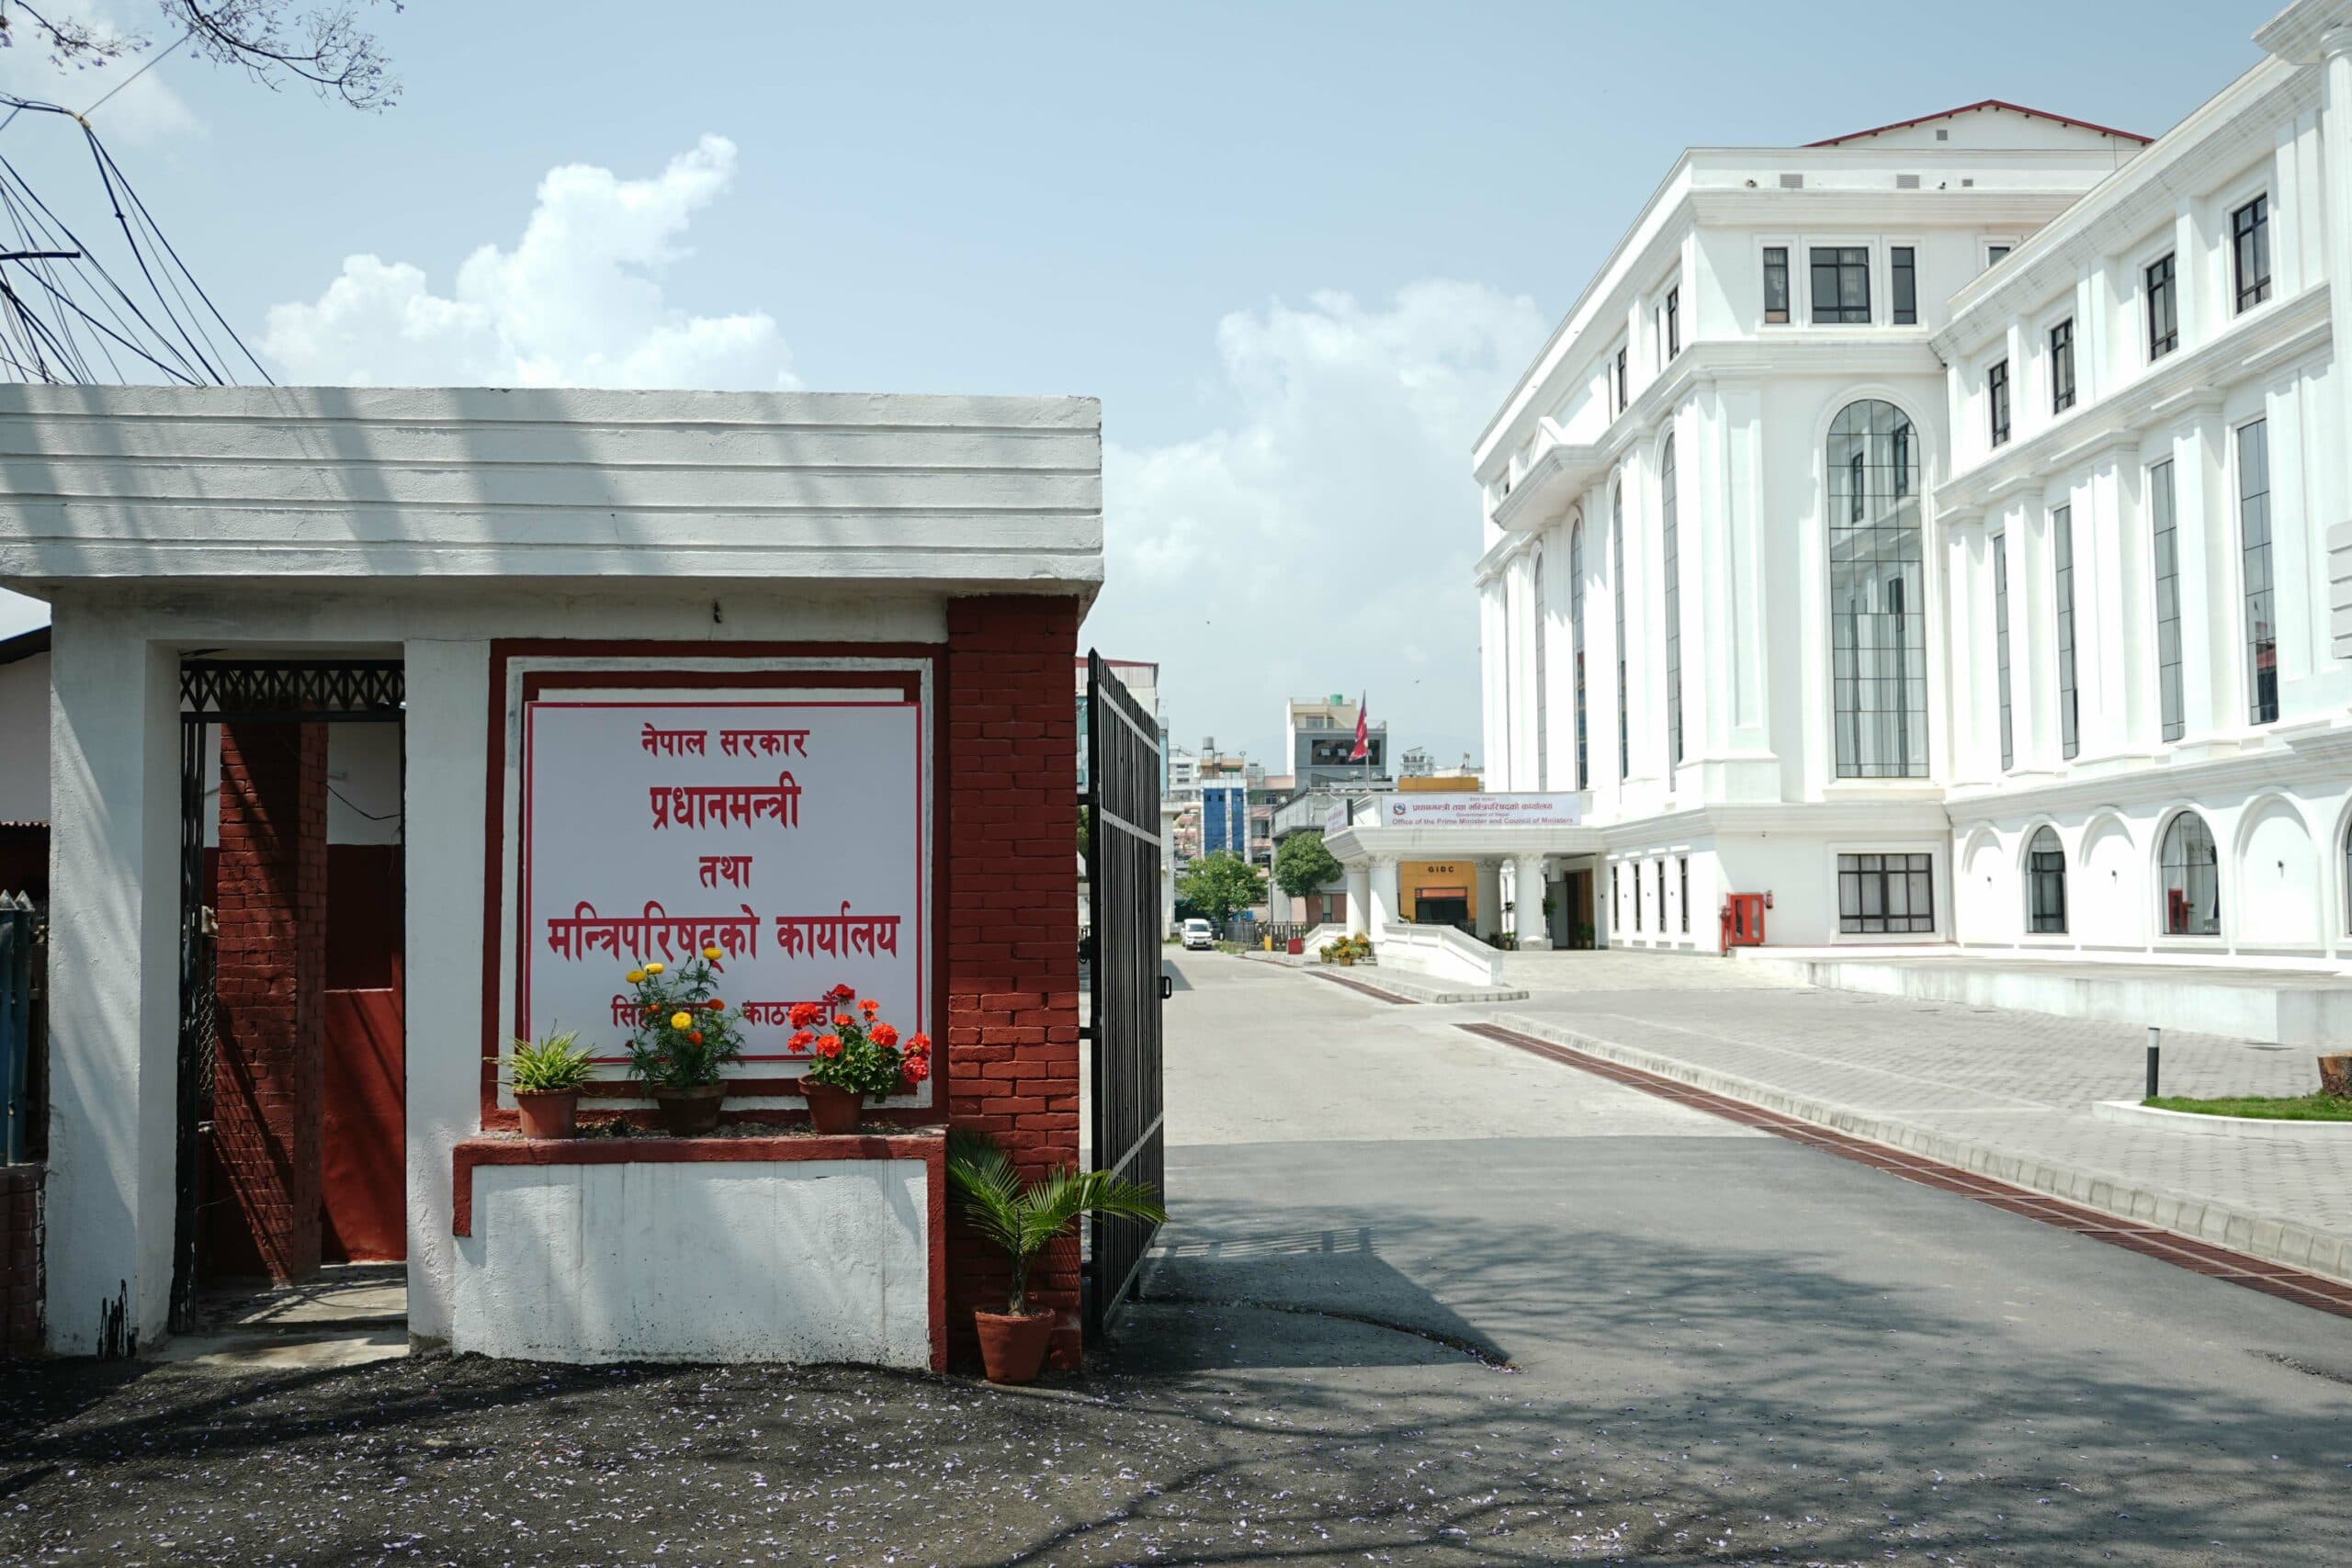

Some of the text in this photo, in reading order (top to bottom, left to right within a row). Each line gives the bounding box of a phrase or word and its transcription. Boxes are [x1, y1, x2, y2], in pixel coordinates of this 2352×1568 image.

[641, 723, 809, 758] नेपाल सरकार
[650, 771, 801, 830] प्रधानमन्त्री
[699, 856, 752, 889] तथा
[775, 901, 900, 959] कार्यालय
